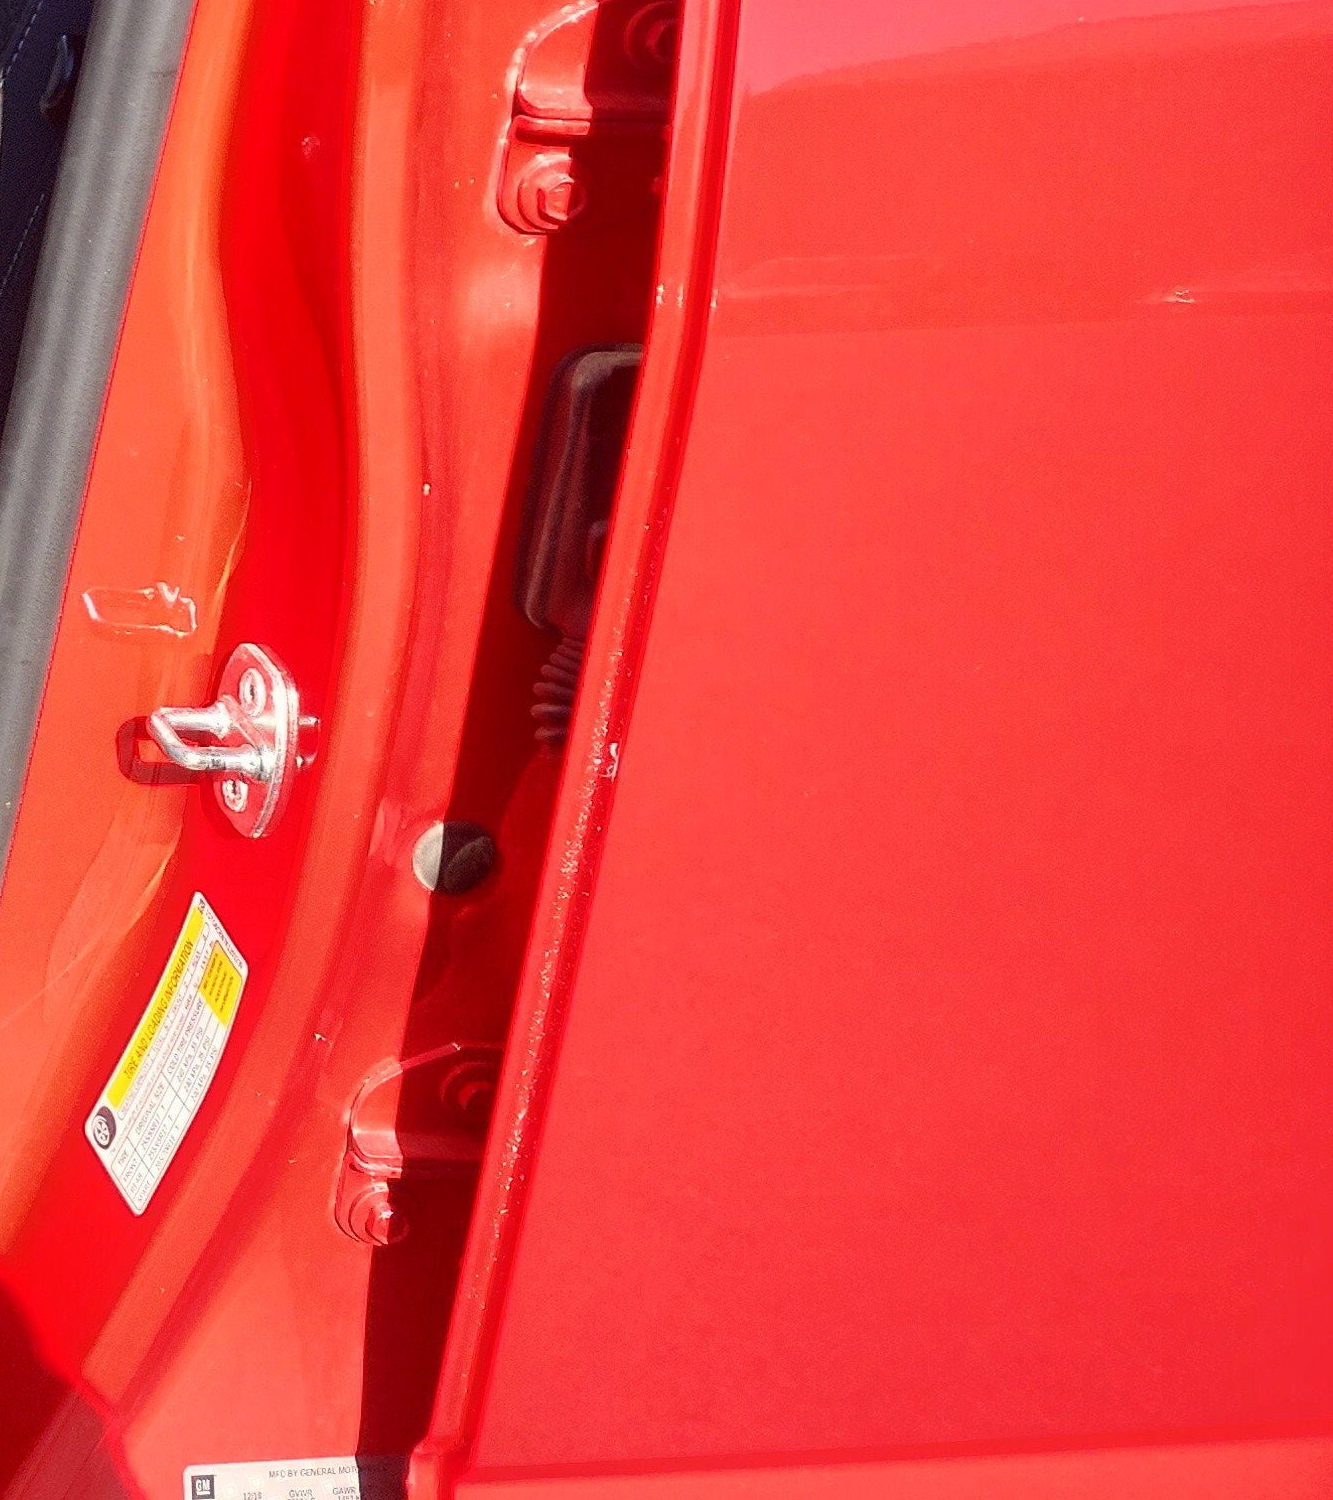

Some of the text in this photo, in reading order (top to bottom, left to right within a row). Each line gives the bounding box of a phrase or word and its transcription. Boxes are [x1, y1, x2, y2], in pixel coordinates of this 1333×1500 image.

[123, 1053, 139, 1081] TIRE
[133, 1035, 148, 1060] AND
[142, 995, 168, 1042] LOADING
[161, 937, 195, 1002] INFORMATION
[300, 1467, 336, 1477] GENERAL
